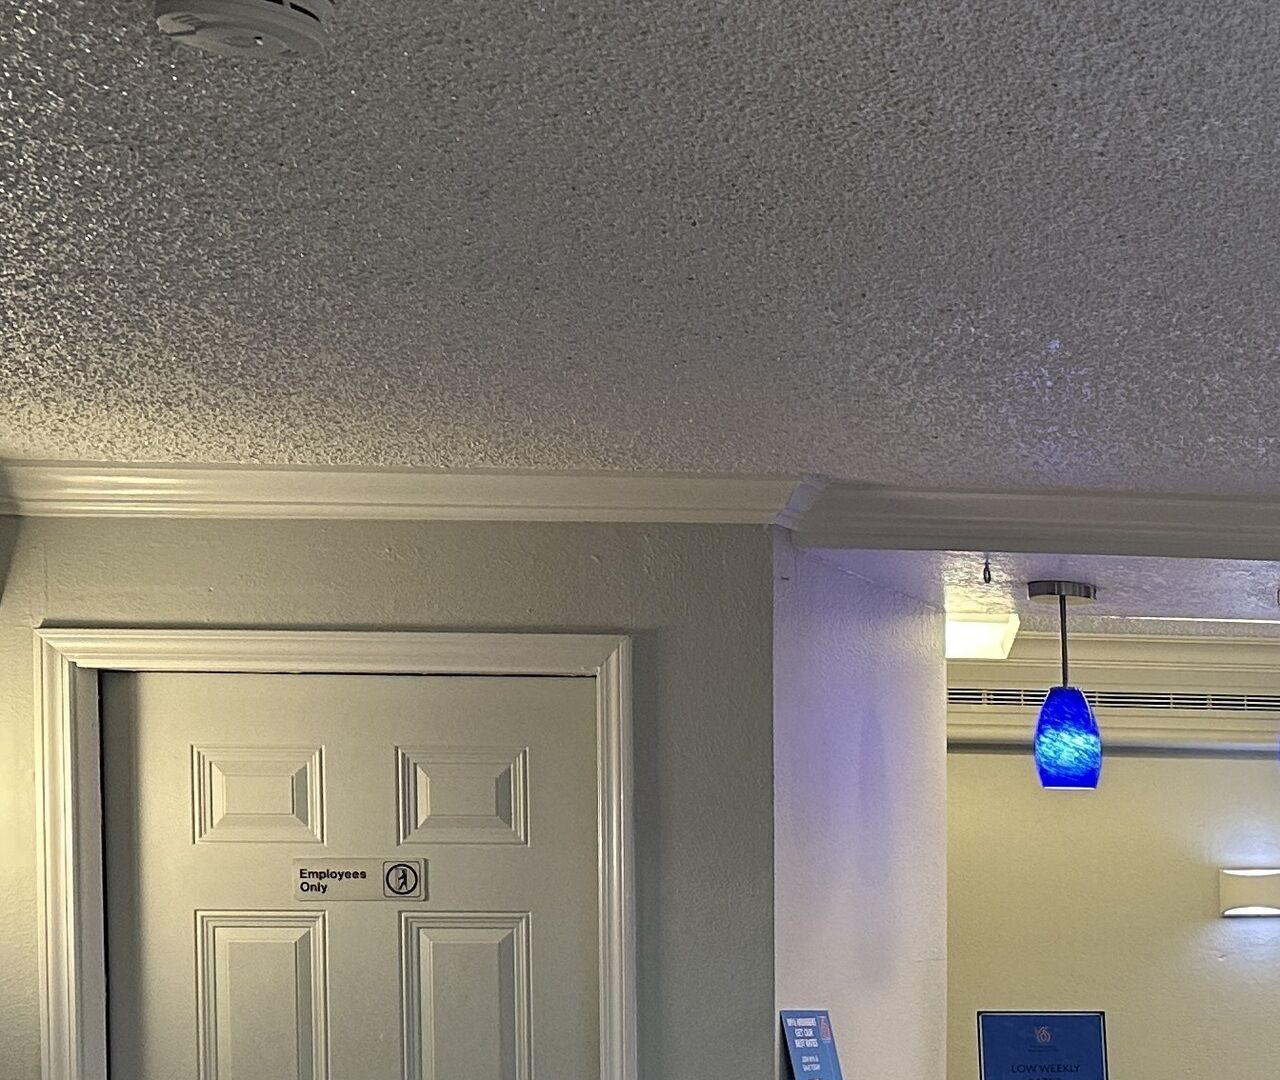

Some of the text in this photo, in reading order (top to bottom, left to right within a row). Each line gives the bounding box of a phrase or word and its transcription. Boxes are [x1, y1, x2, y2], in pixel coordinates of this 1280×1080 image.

[299, 868, 367, 882] Employees
[300, 881, 328, 894] Only
[1011, 1063, 1081, 1074] LOW WEEKLY
